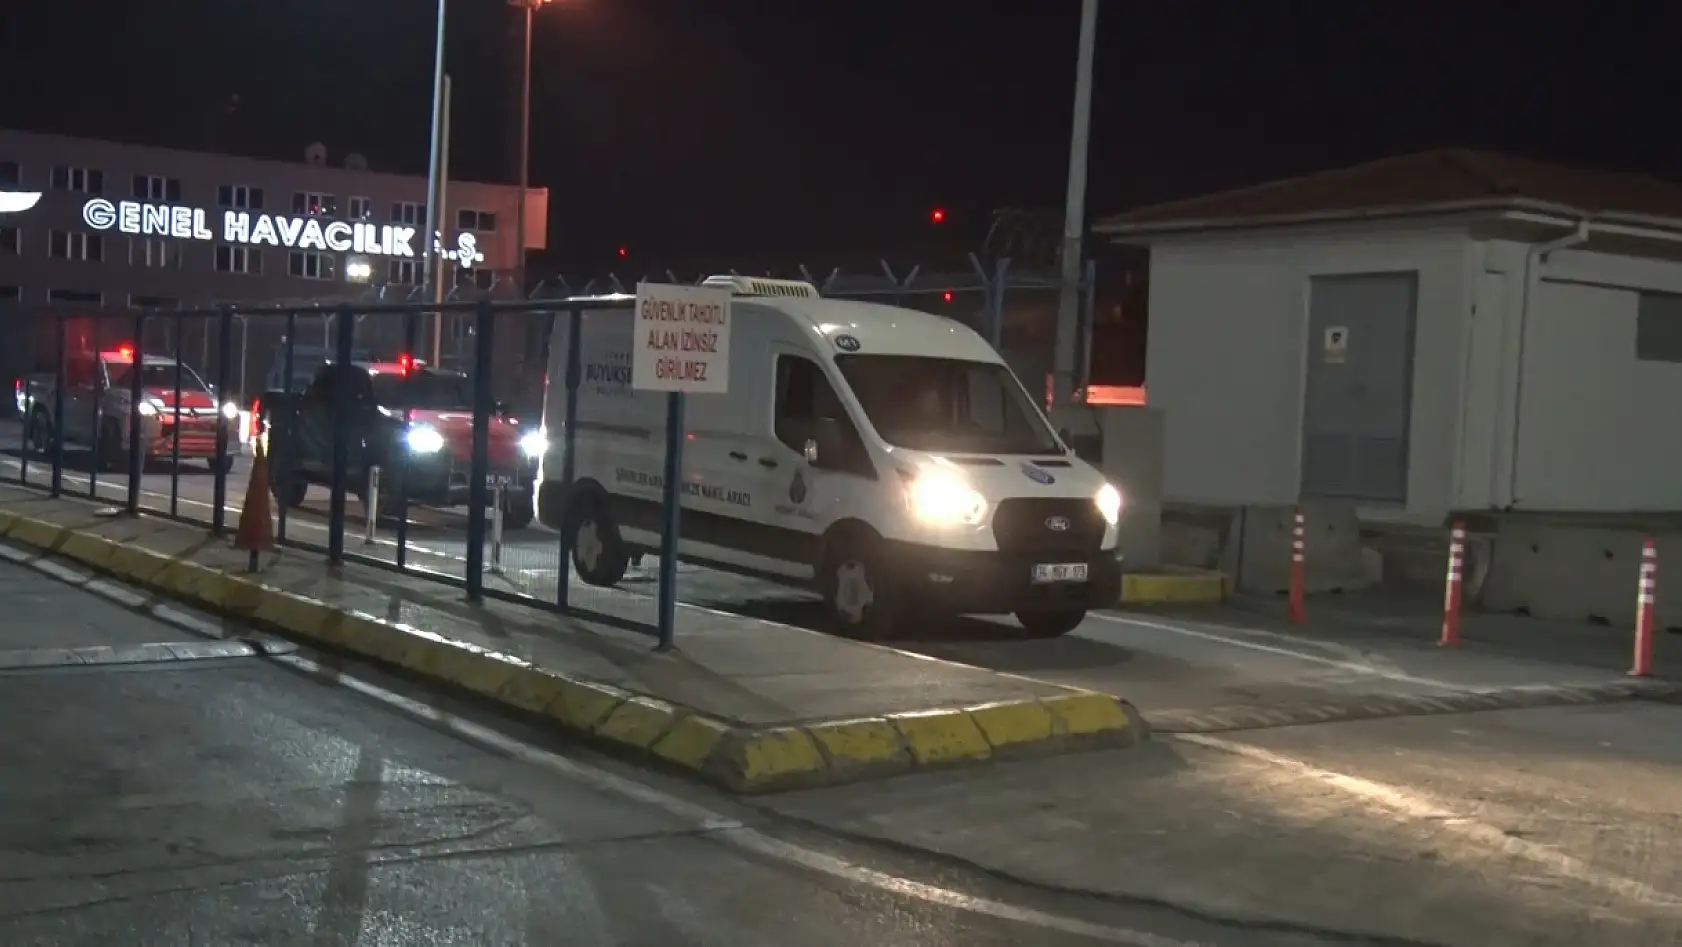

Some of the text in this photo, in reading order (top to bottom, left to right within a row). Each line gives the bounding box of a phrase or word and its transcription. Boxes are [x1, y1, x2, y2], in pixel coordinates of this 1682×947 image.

[83, 198, 212, 240] GENEL
[224, 210, 414, 257] HAVACILIK
[647, 328, 718, 353] ALAN İZİNSİZ
